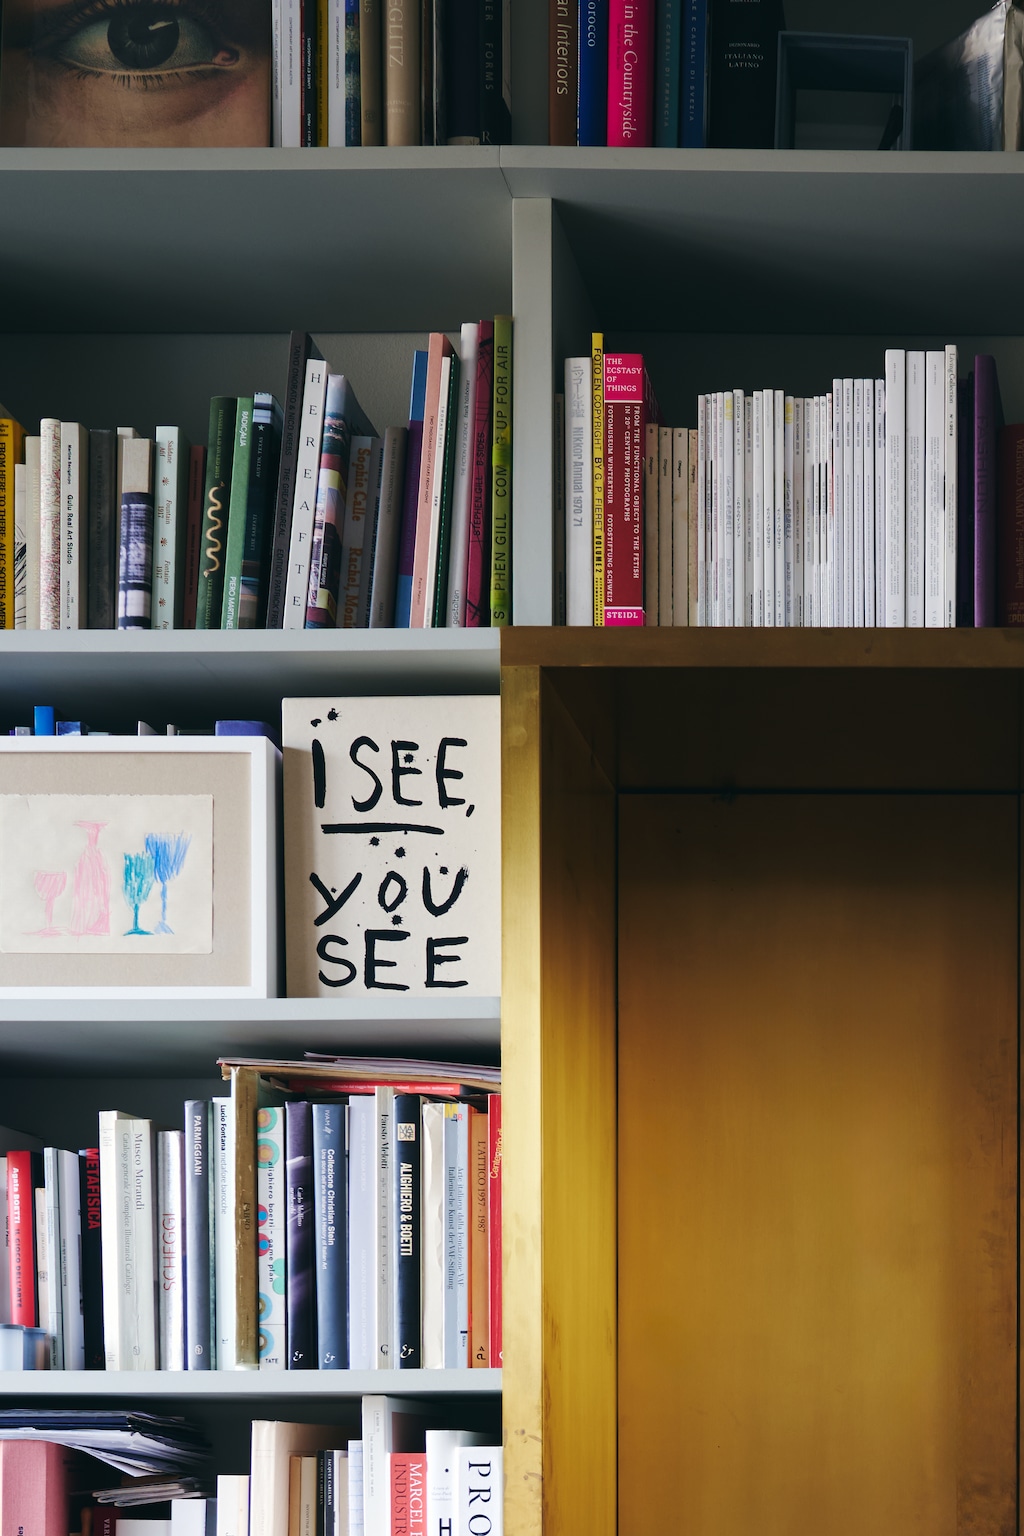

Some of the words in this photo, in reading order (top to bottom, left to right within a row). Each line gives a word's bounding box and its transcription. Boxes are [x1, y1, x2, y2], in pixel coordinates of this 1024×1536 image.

[625, 5, 638, 19] in
[624, 24, 638, 46] the
[556, 24, 572, 95] Interiors
[618, 51, 638, 138] Countryside
[497, 345, 508, 370] AIR
[593, 348, 602, 376] FOTO
[606, 367, 642, 375] ECSTASY
[496, 375, 507, 403] FOR
[593, 378, 602, 392] EN
[606, 376, 617, 384] OF
[496, 407, 507, 429] UP
[593, 394, 602, 450] COPYRIGHT
[573, 427, 583, 460] Nikkor
[353, 447, 370, 487] Sophie
[573, 461, 583, 494] Annual
[594, 458, 602, 470] BY
[66, 494, 74, 510] Gulu
[352, 489, 366, 522] Calle
[594, 498, 602, 532] FIERET
[66, 512, 74, 528] Real
[66, 530, 74, 540] Art
[633, 524, 640, 534] TO
[66, 542, 74, 564] Studio
[606, 514, 614, 568] FOTOSTIFTUNG
[344, 547, 363, 591] Rachel,
[350, 736, 475, 818] SEE,
[316, 928, 469, 992] SEE
[134, 1133, 144, 1165] Museo
[194, 1115, 202, 1175] PARMIGGIANI
[220, 1123, 228, 1151] Fontana
[220, 1152, 228, 1182] metafore
[327, 1149, 335, 1188] Collezione
[85, 1147, 100, 1229] METAFISICA
[135, 1169, 144, 1210] Morandi
[220, 1184, 228, 1214] barocche
[400, 1162, 413, 1212] ALIGHIERO
[327, 1190, 335, 1224] Christian
[327, 1226, 335, 1245] Stein
[400, 1224, 413, 1256] BOETTI
[409, 1463, 422, 1527] MARCEL
